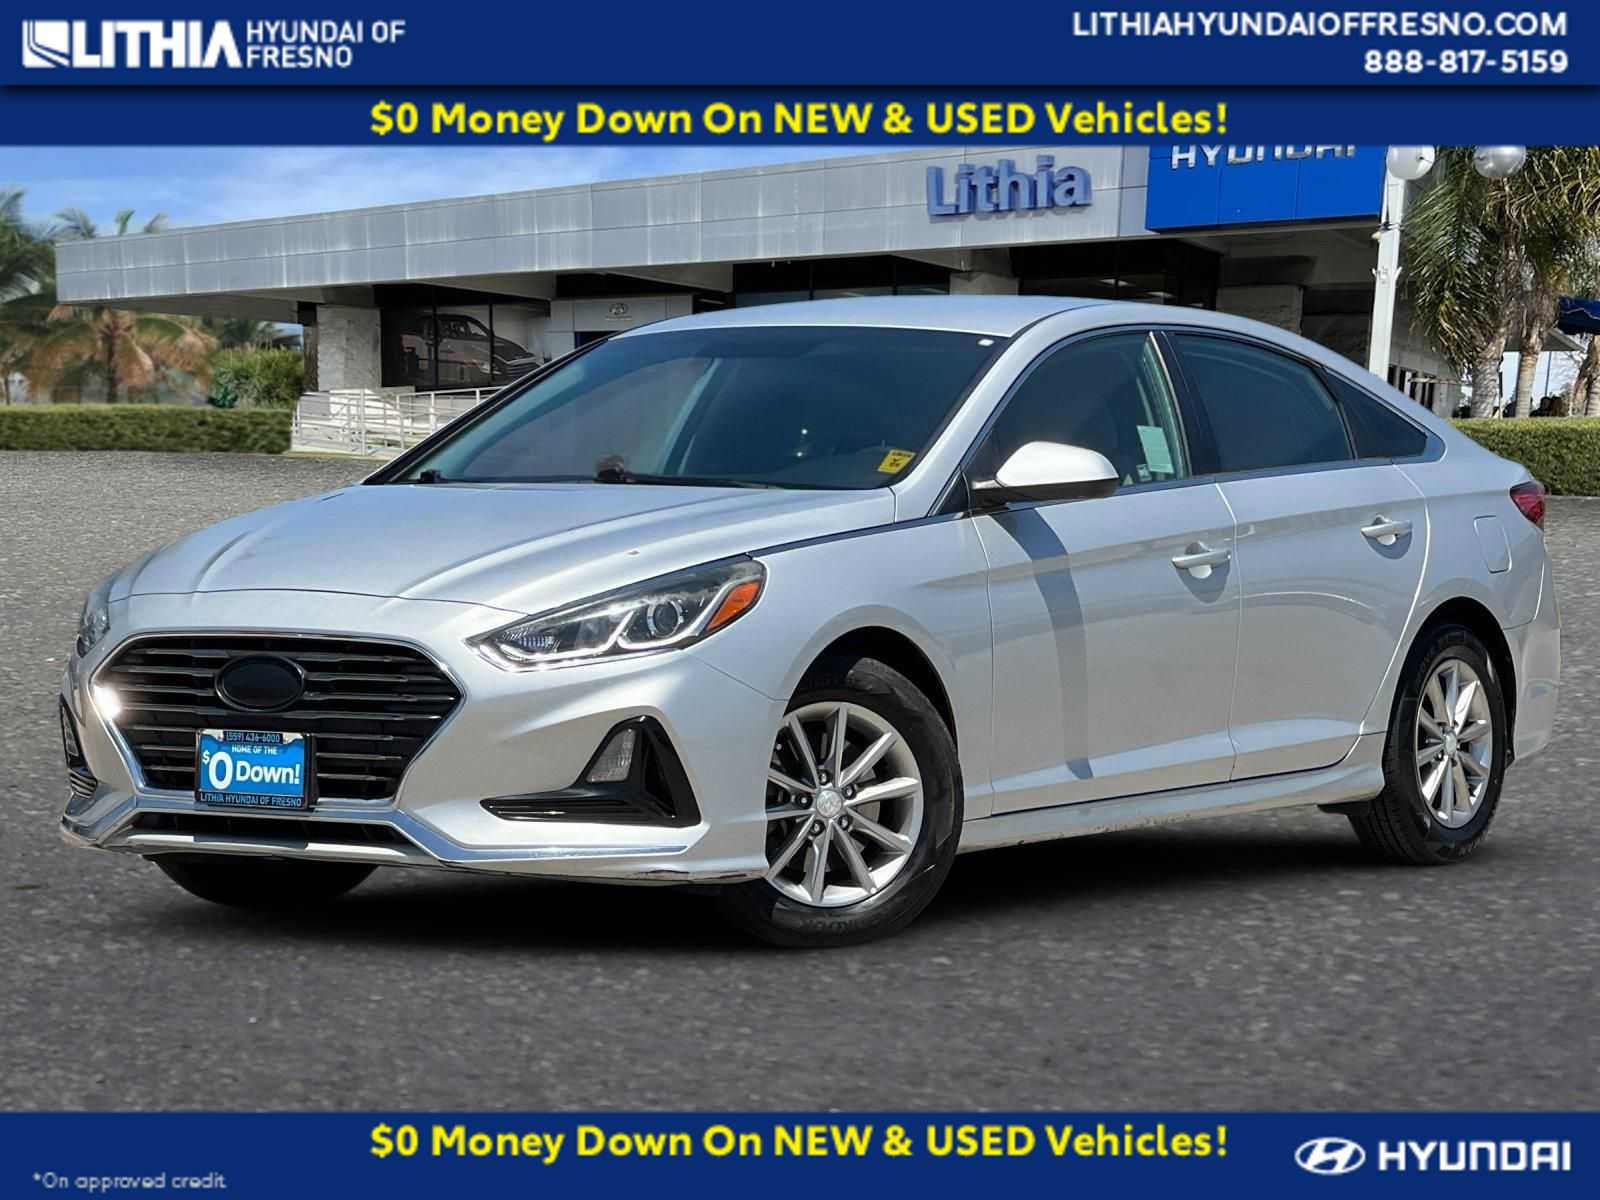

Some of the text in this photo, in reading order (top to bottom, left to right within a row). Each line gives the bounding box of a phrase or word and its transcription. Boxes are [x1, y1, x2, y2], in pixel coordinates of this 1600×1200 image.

[926, 154, 1092, 216] Lithia
[231, 744, 278, 755] HOME OF THE
[236, 760, 300, 784] Down!
[200, 792, 302, 807] LITHIA HYUNDAI OF FRESNO
